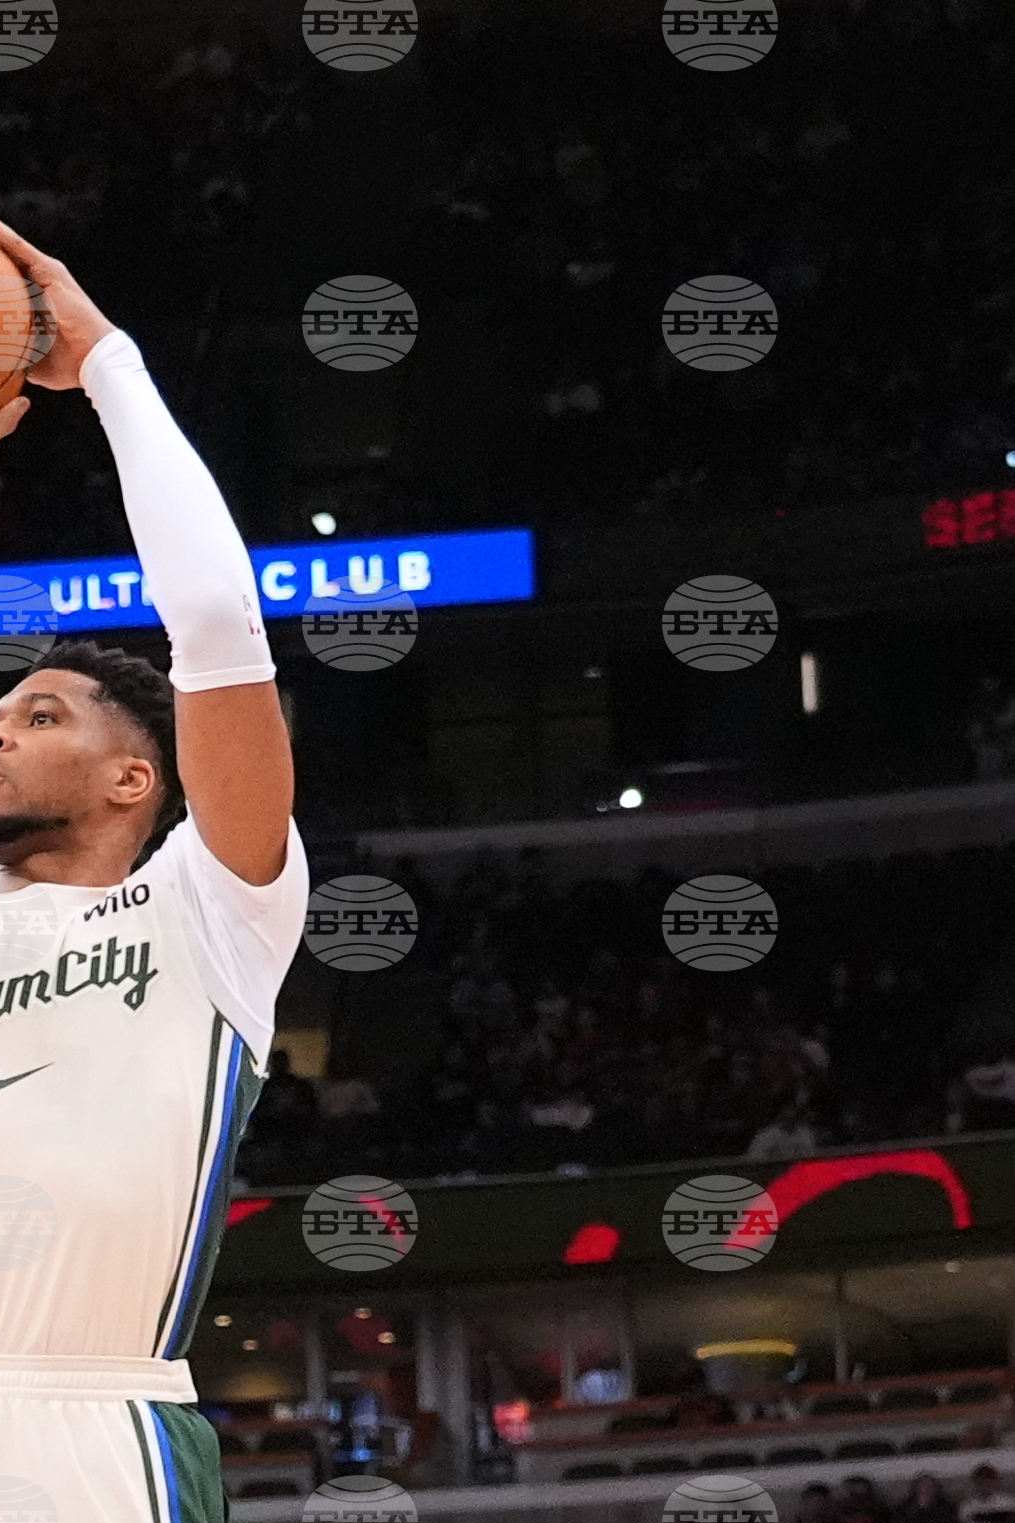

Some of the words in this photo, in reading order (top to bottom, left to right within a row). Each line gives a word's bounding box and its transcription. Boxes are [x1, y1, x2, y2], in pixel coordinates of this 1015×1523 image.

[261, 551, 431, 600] CLUB
[84, 883, 150, 921] wilo
[56, 936, 158, 1011] City
